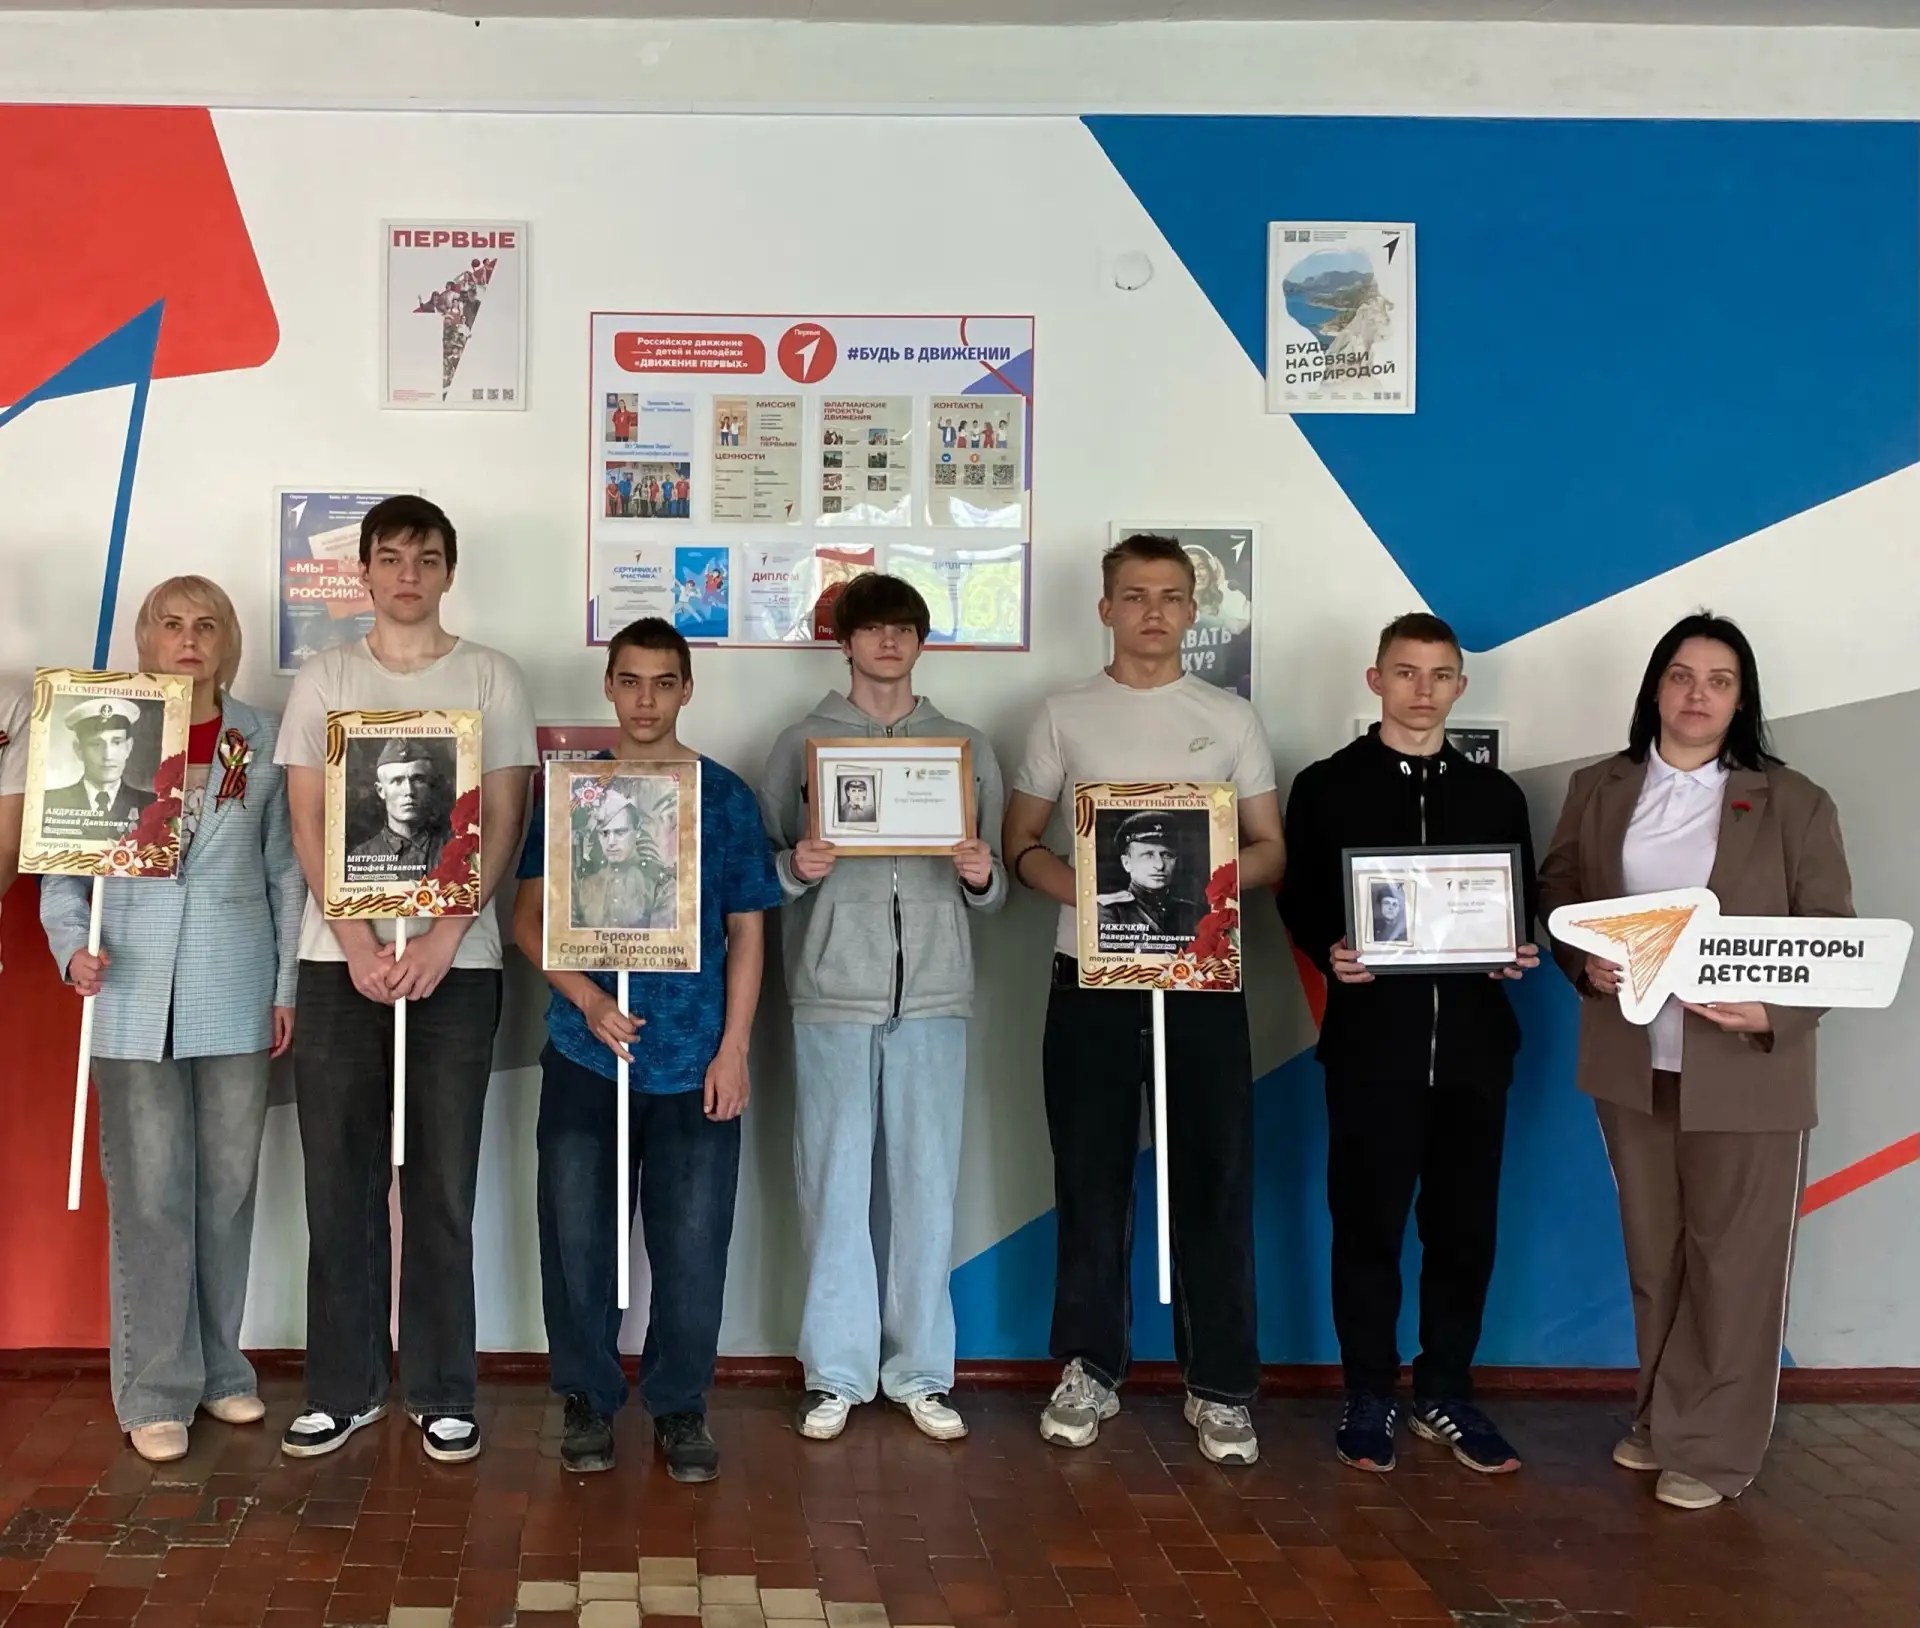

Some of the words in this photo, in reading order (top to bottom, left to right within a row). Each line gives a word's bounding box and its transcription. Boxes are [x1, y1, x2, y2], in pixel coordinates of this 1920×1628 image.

[393, 230, 516, 249] ПЕРВЫЕ
[637, 337, 693, 347] Российское
[694, 339, 743, 347] движение
[655, 348, 683, 357] детей
[694, 348, 743, 358] молодёжи
[847, 347, 900, 363] #БУДЬ
[904, 347, 915, 360] В
[918, 347, 1011, 363] ДВИЖЕНИИ
[634, 358, 698, 369] «ДВИЖЕНИЕ
[700, 359, 748, 369] ПЕРВЫХ»
[1286, 358, 1309, 370] НА
[1312, 351, 1369, 367] СВЯЗИ
[1285, 373, 1297, 385] С
[1300, 360, 1395, 384] ПРИРОДОЙ
[756, 401, 796, 409] МИССИЯ
[824, 401, 887, 409] ФЛАГМАНСКИЕ
[933, 402, 984, 410] КОНТАКТЫ
[715, 452, 766, 461] ЦЕННОСТИ
[289, 563, 324, 574] «МЫ
[319, 576, 364, 588] ГРАЖ
[289, 587, 365, 599] РОССИИ!»
[56, 683, 133, 697] БЕССМЕРТНЫЙ
[135, 688, 165, 699] ПОЛК
[349, 726, 425, 735] БЕССМЕРТНЫЙ
[426, 726, 455, 735] ПОЛК
[1097, 799, 1175, 808] БЕССМЕРТНЫЙ
[1177, 799, 1208, 807] ПОЛК
[44, 816, 80, 826] Николай
[82, 818, 129, 828] Данилович
[36, 841, 82, 850] moypolk.ru
[347, 855, 399, 863] МИТРОШИН
[347, 864, 385, 873] Тимофей
[386, 864, 427, 872] Иванович
[340, 885, 385, 894] moypolk.ru
[1100, 923, 1150, 932] РЯЖЕЧКИН
[594, 930, 650, 943] Терехов
[1100, 932, 1140, 941] Валерьян
[1142, 933, 1196, 943] Григорьевич
[560, 942, 608, 956] Сергей
[612, 943, 685, 956] Тарасович
[1699, 938, 1865, 959] НАВИГАТОРЫ
[1089, 955, 1135, 963] moypolk.ru
[1698, 964, 1810, 985] ДЕТСТВА
